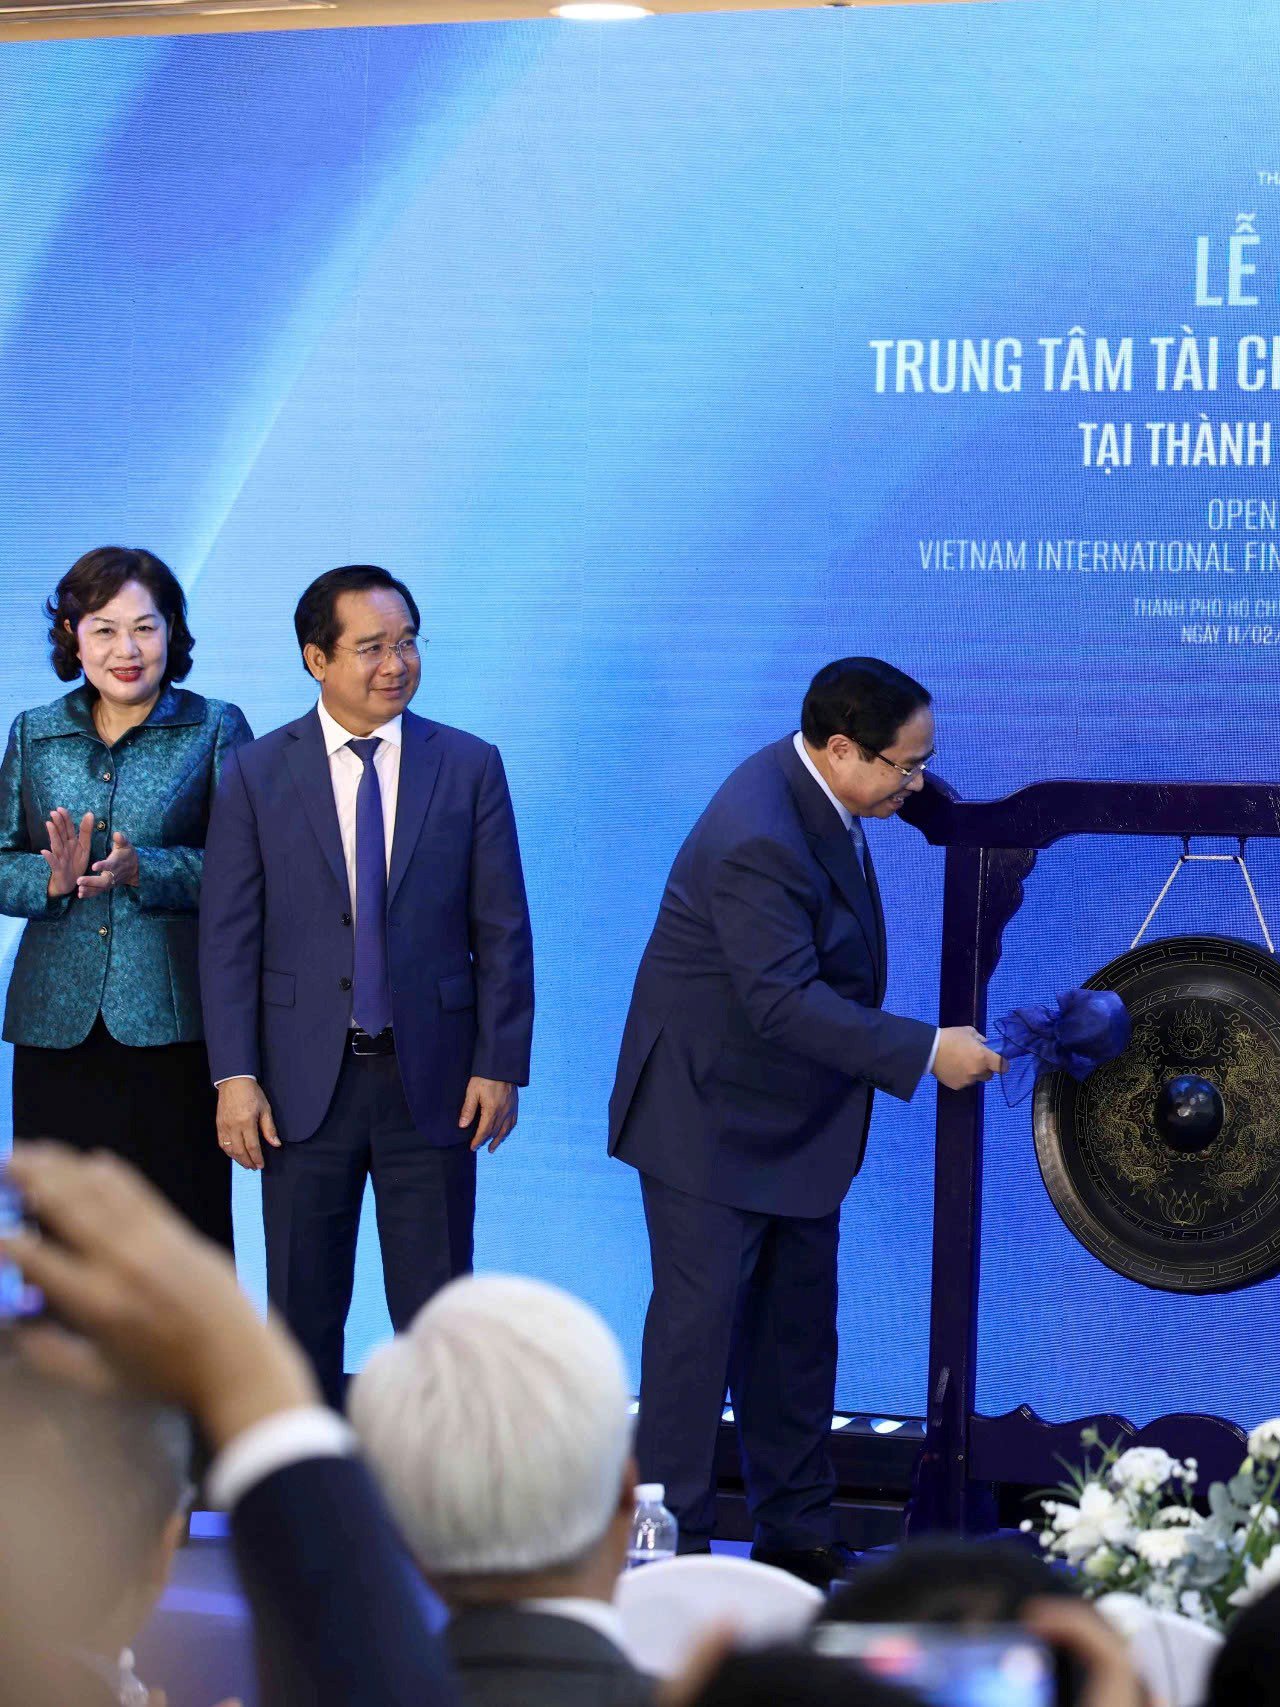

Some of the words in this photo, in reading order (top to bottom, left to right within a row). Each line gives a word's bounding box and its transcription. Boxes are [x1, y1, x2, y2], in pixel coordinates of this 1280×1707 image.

[1195, 213, 1260, 306] LỄ
[870, 337, 1022, 393] TRUNG
[1038, 325, 1132, 392] TÂM
[1150, 324, 1219, 391] TÀI
[1079, 422, 1132, 475] TẠI
[1146, 413, 1270, 467] THÀNH
[919, 540, 1026, 571] VIETNAM
[1038, 541, 1236, 573] INTERNATIONAL
